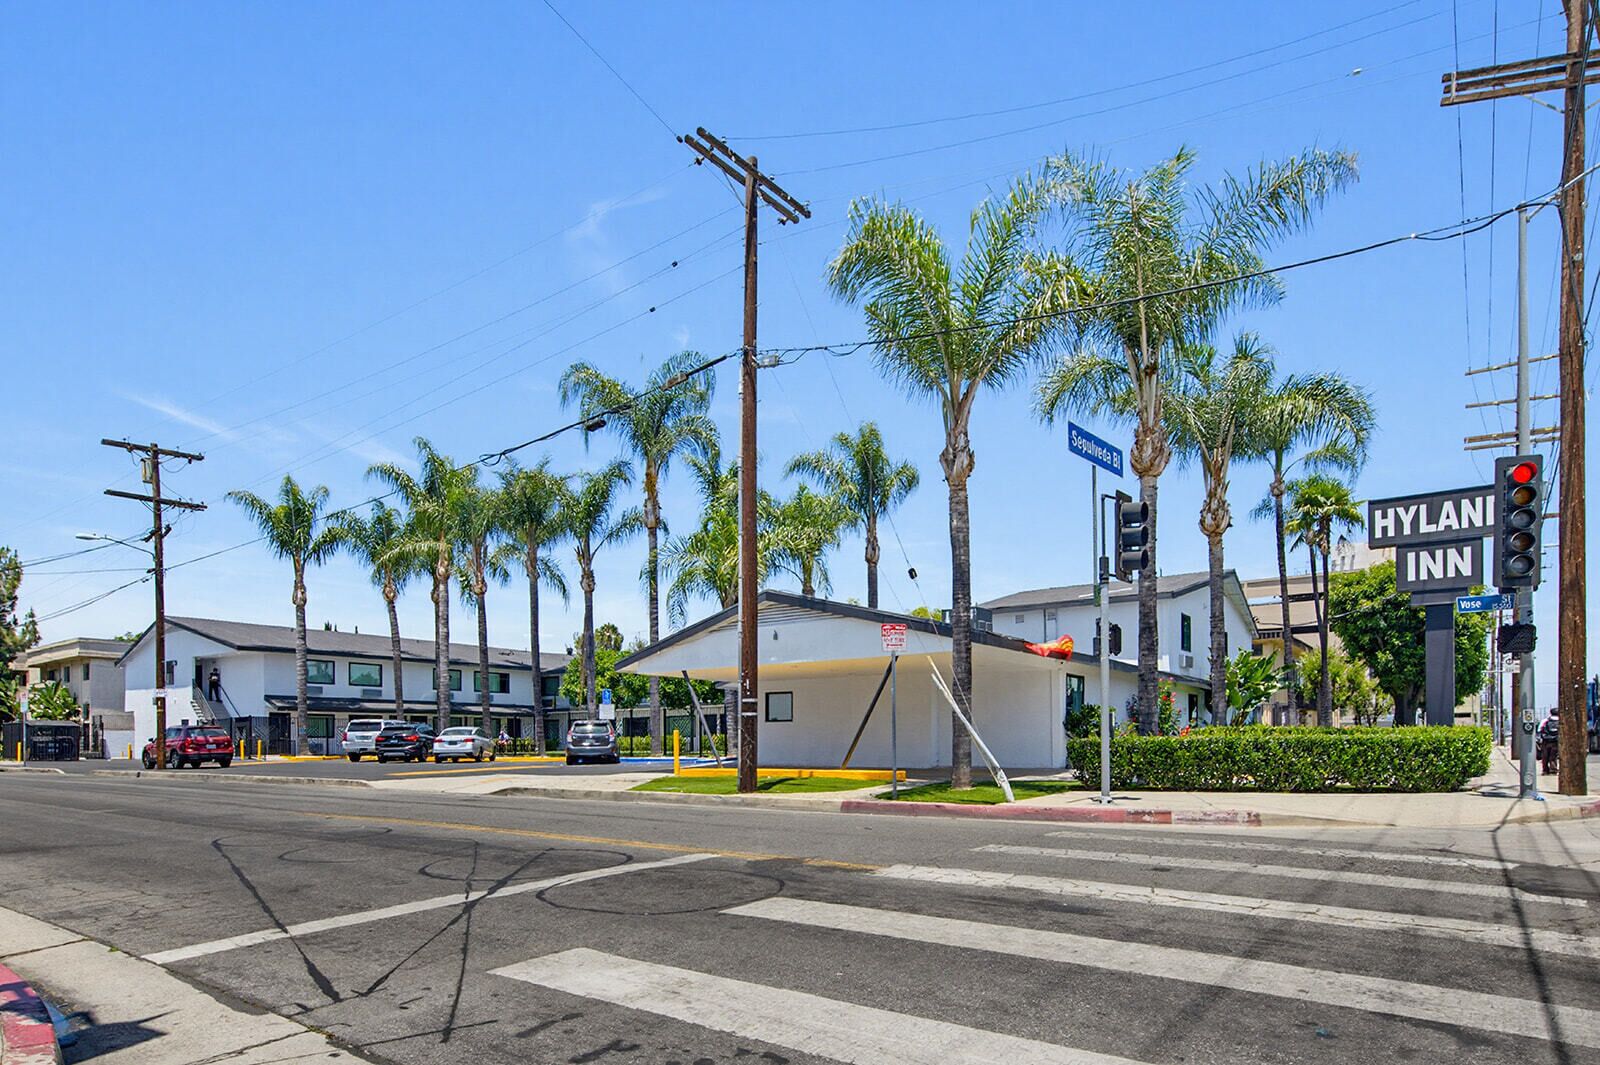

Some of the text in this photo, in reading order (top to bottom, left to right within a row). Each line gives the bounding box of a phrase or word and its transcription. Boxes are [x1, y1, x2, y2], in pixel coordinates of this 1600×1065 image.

[1071, 430, 1111, 464] Sepulveda
[1407, 546, 1472, 582] INN
[1460, 600, 1481, 609] Vose
